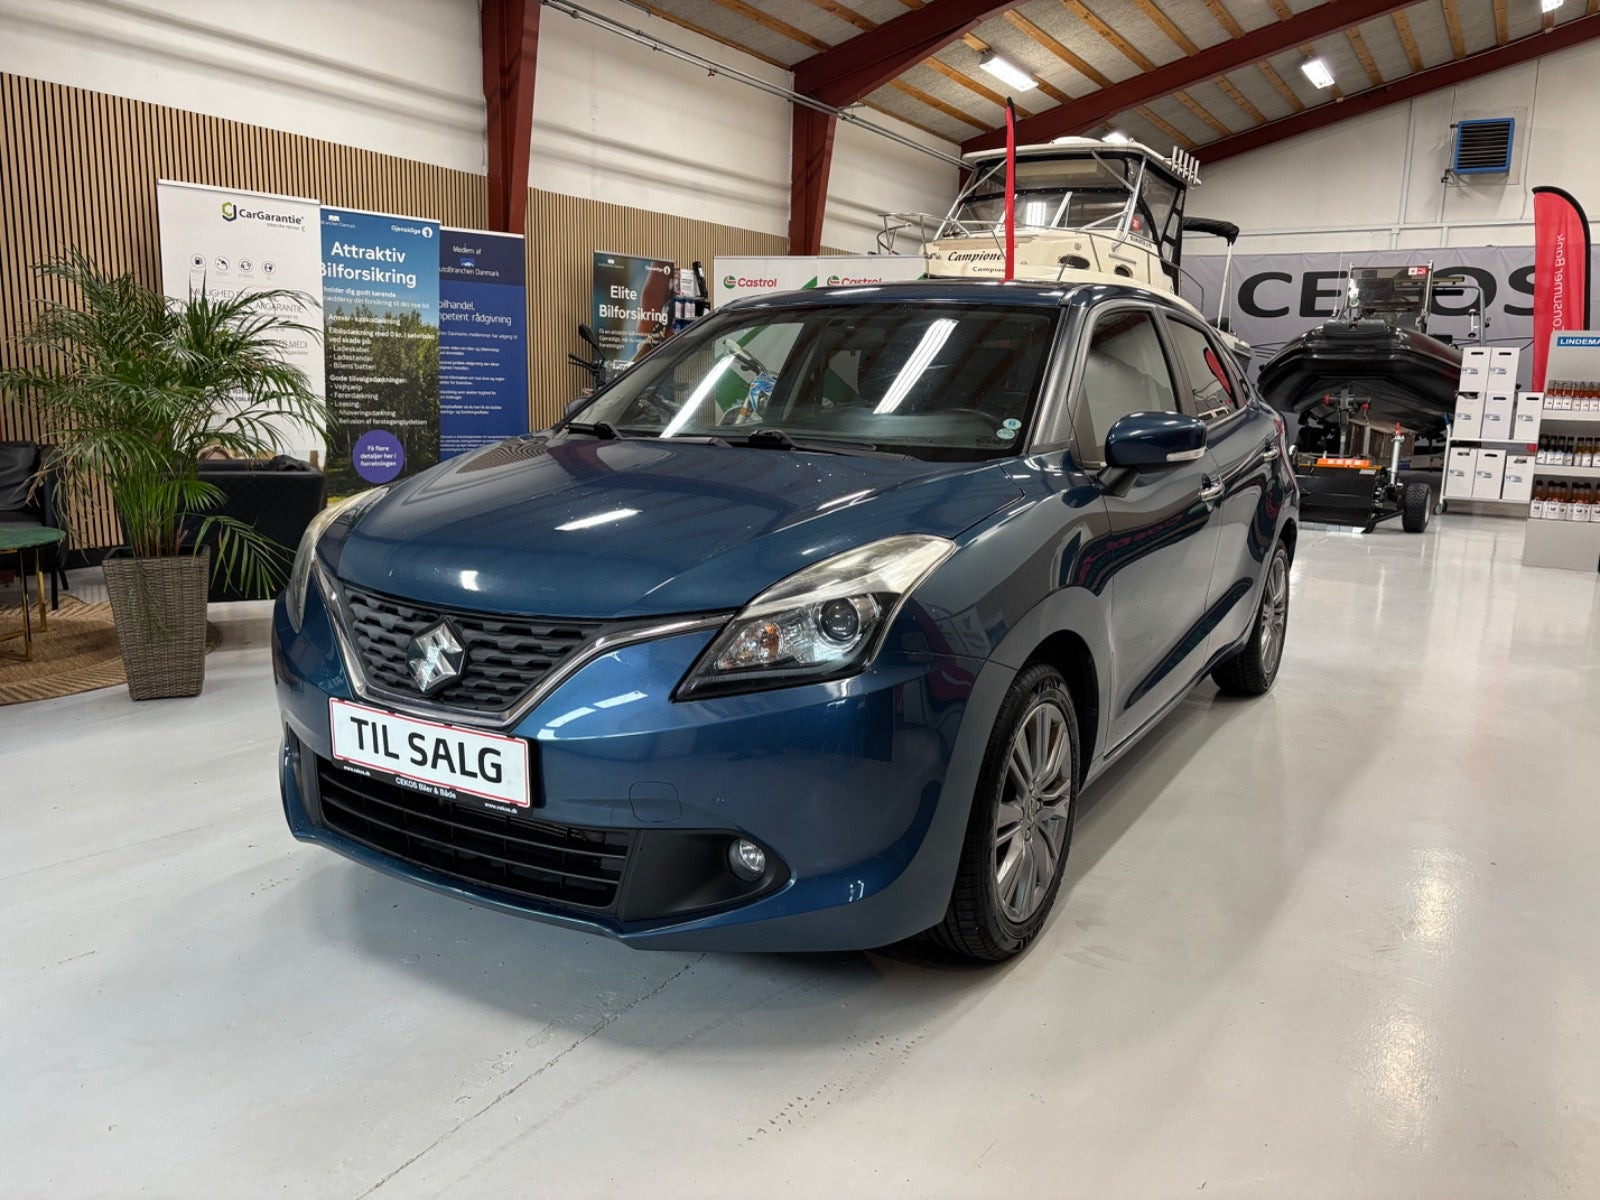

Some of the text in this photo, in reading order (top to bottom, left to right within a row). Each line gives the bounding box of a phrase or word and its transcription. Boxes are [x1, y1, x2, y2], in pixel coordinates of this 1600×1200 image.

[239, 209, 302, 224] CarGarantie
[331, 241, 406, 263] Attraktiv
[320, 262, 417, 289] Bilforsikring
[737, 277, 778, 288] Castrol
[610, 285, 638, 300] Elite
[1237, 265, 1536, 318] CEOS
[599, 304, 668, 325] Bilforsikring
[350, 716, 502, 784] TIL SALG
[418, 782, 433, 793] Biler
[433, 786, 439, 795] &
